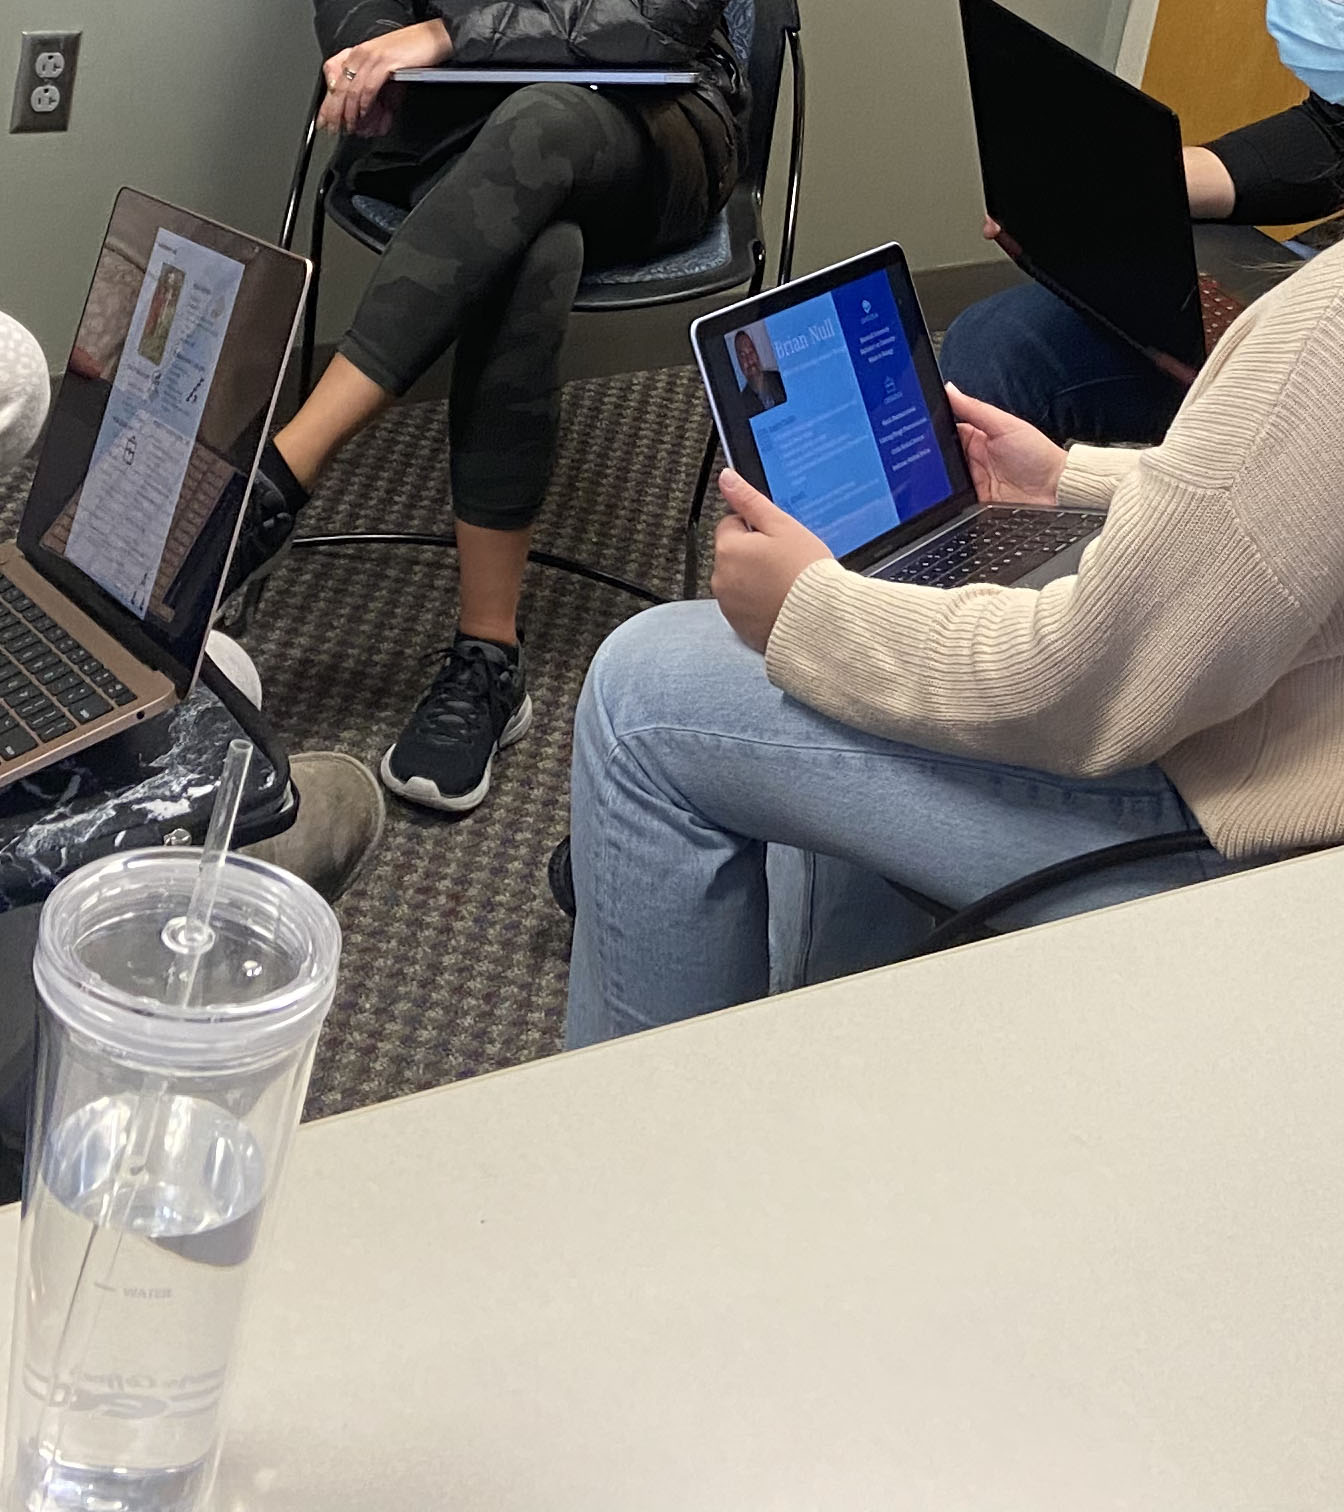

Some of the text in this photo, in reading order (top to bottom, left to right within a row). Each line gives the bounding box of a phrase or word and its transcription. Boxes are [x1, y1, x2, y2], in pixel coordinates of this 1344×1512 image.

[774, 333, 809, 359] Brian
[808, 318, 835, 345] Null
[123, 1287, 172, 1299] WATER
